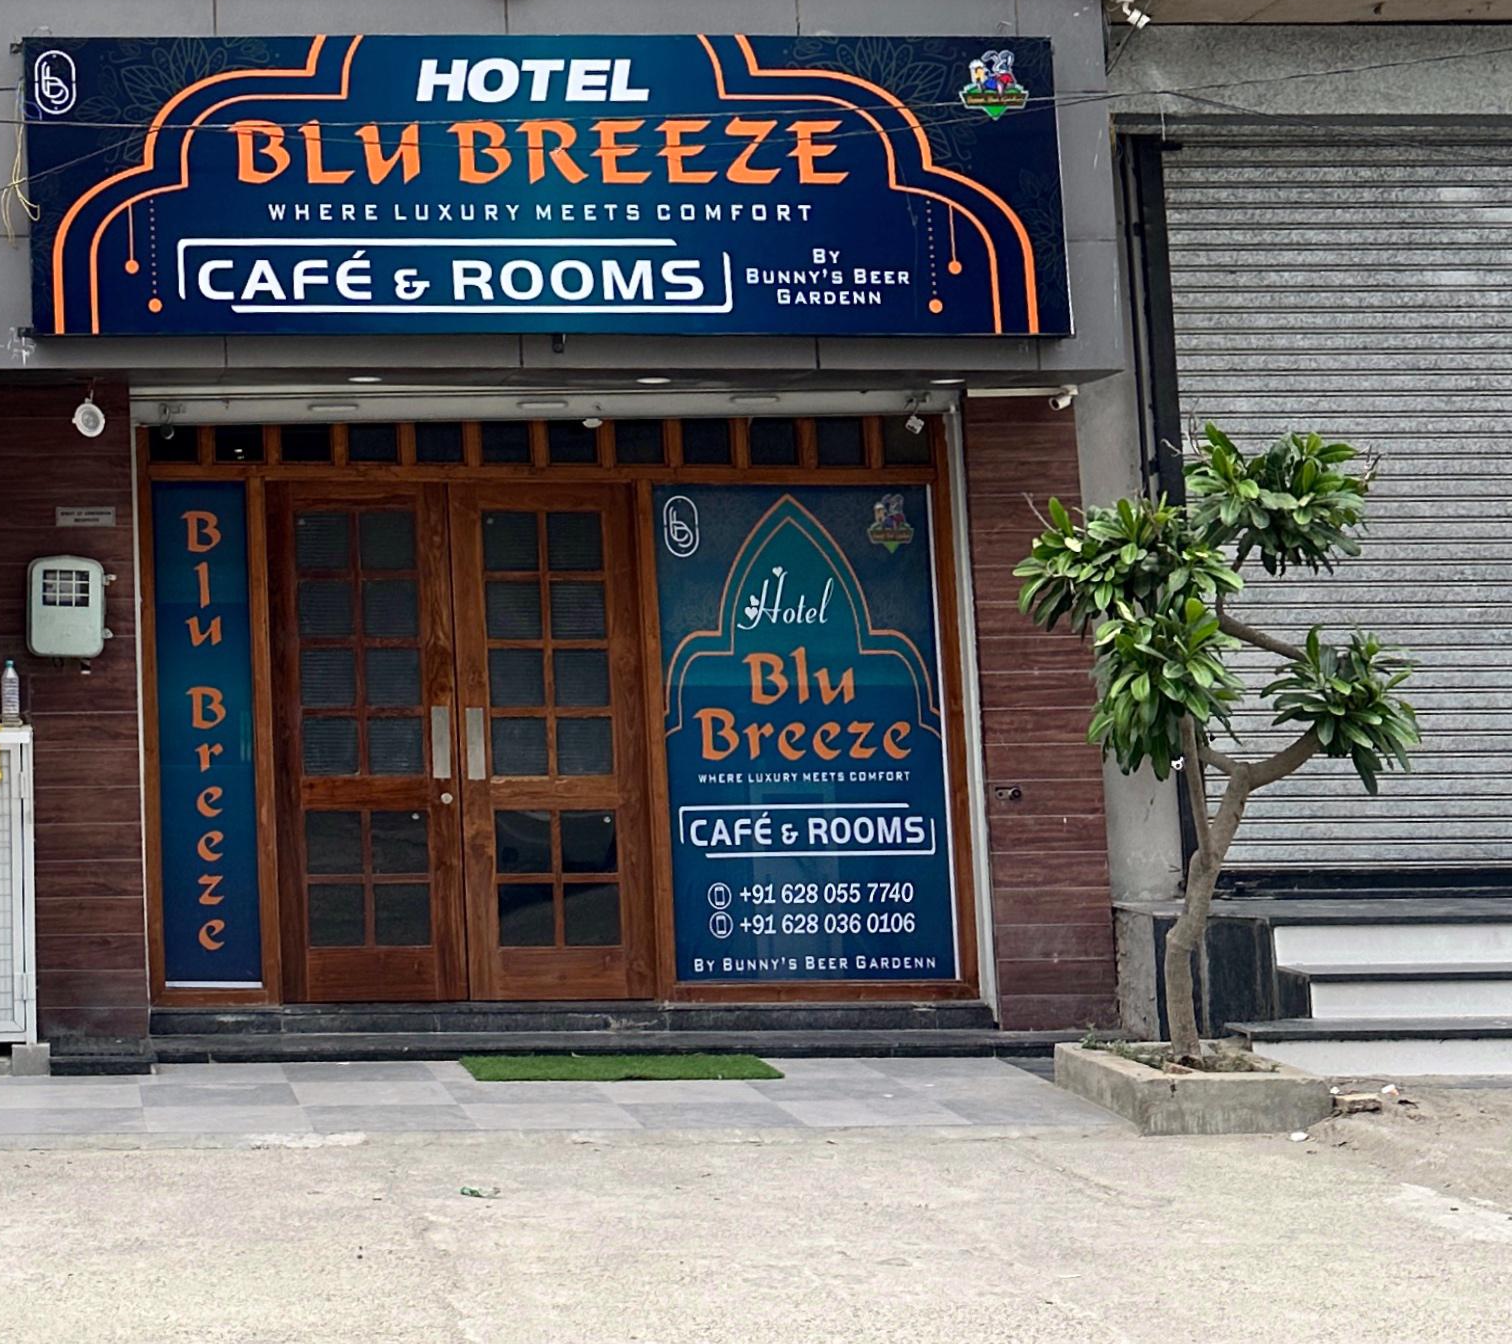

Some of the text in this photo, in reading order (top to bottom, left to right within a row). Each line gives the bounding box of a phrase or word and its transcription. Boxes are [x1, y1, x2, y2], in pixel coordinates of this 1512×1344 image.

[415, 57, 650, 103] HOTEL
[448, 117, 849, 186] BREEZE
[268, 203, 813, 222] WHERE LUXURY MEETS COMFORT
[198, 249, 705, 301] CAFÉ & ROOMS
[737, 568, 834, 630] Hotel
[742, 646, 856, 705] Blu
[180, 511, 227, 950] Blu Breeze
[693, 707, 912, 761] Breeze
[698, 770, 911, 784] WHERE LUXURY MEETS COMFORT
[689, 811, 926, 846] CAFÉ & ROOMS
[739, 882, 915, 905] +91 628 055 7740
[739, 912, 916, 935] +91 628 036 0106
